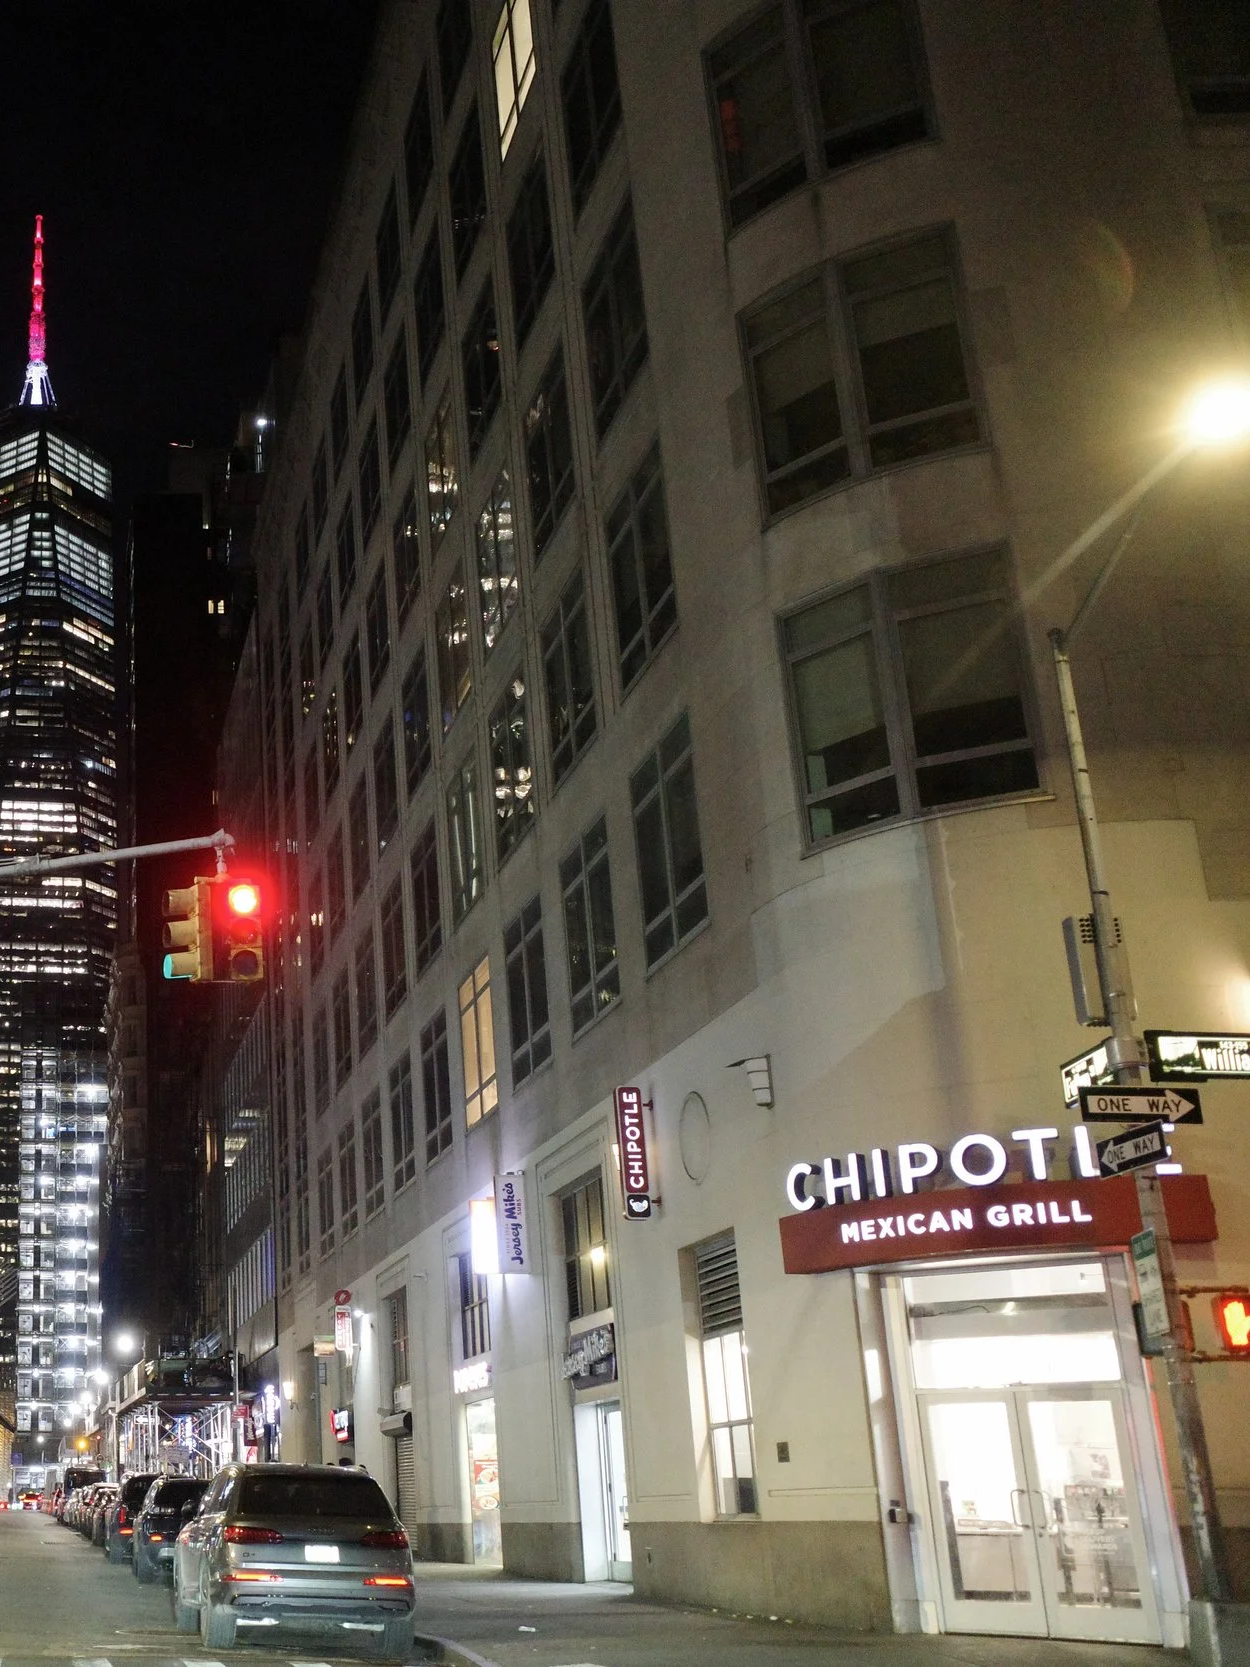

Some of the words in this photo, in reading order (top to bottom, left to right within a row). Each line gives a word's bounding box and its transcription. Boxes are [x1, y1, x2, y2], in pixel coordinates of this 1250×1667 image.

[1097, 1098, 1132, 1112] ONE
[1147, 1099, 1182, 1112] WAY
[622, 1091, 645, 1188] CHIPOTLE
[1107, 1147, 1126, 1164] ONE
[1133, 1135, 1155, 1155] WAY
[502, 1182, 517, 1220] Mike's
[841, 1208, 973, 1243] MEXICAN
[986, 1200, 1092, 1227] GRILL
[511, 1222, 524, 1265] Jersey
